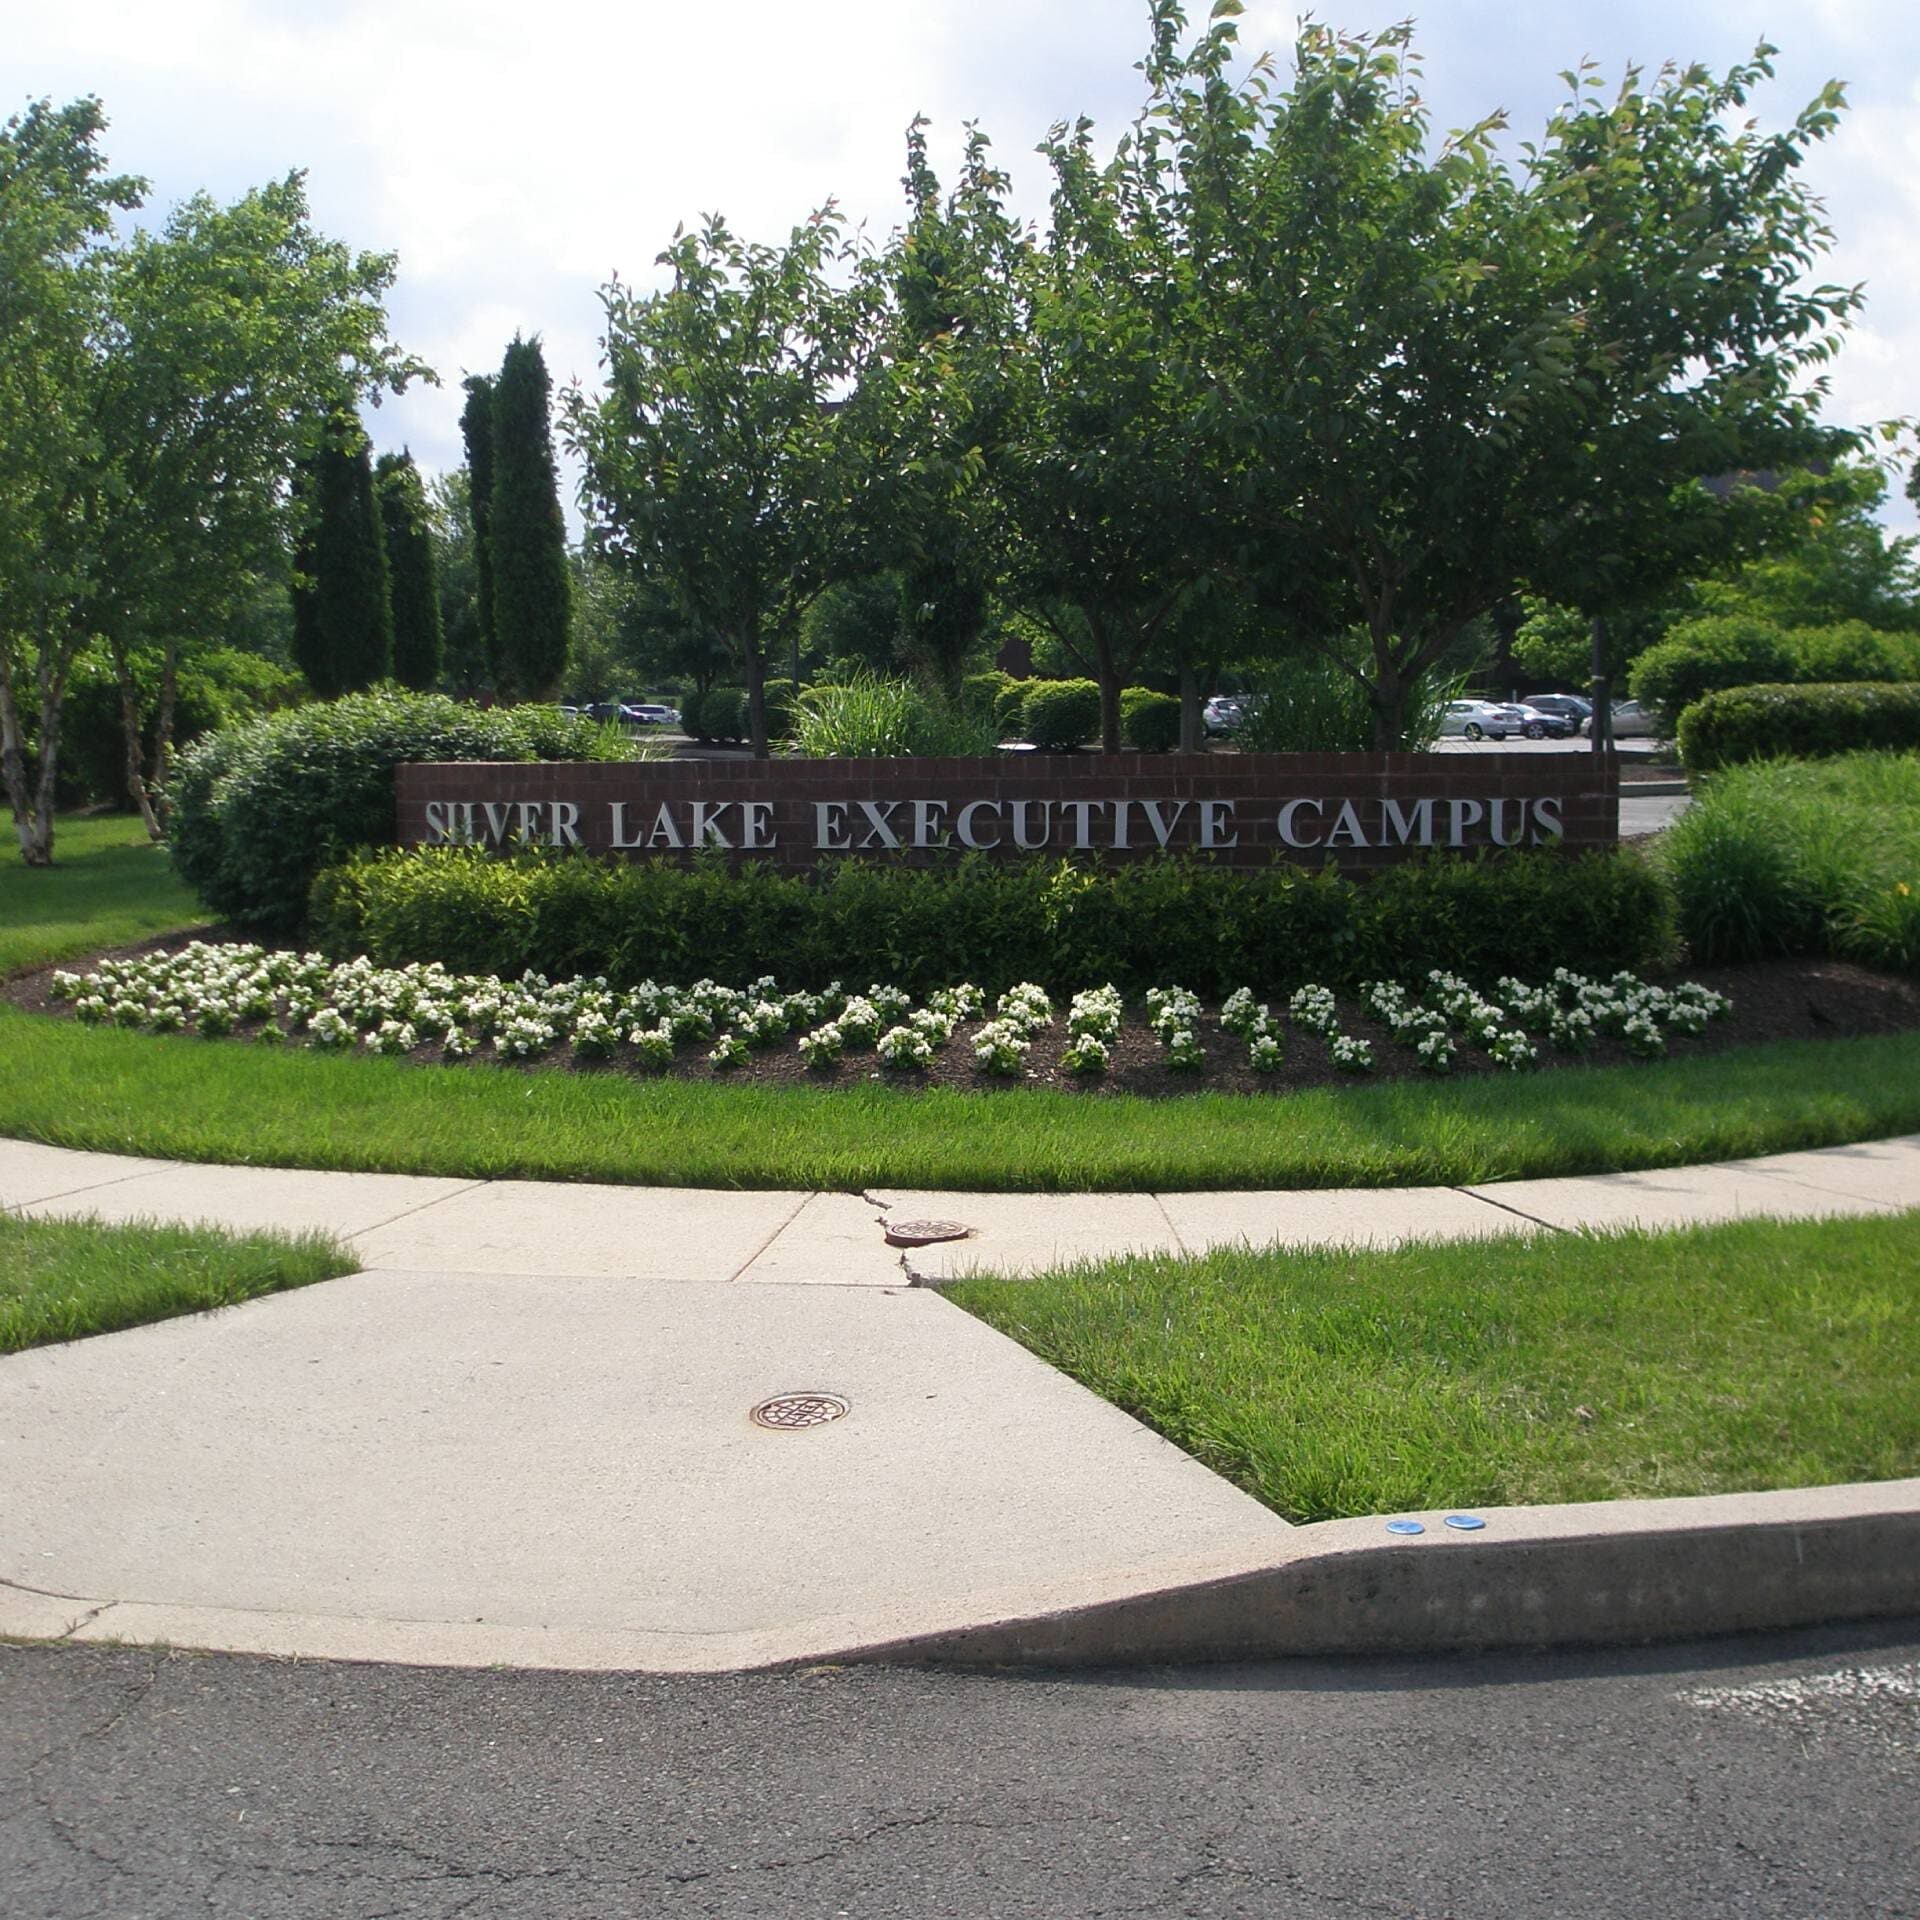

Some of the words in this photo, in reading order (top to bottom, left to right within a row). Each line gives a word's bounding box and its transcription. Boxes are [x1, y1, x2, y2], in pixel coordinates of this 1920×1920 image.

[425, 801, 580, 847] SILVER
[608, 801, 777, 848] LAKE
[811, 799, 1238, 849] EXECUTIVE
[1277, 798, 1564, 848] CAMPUS
